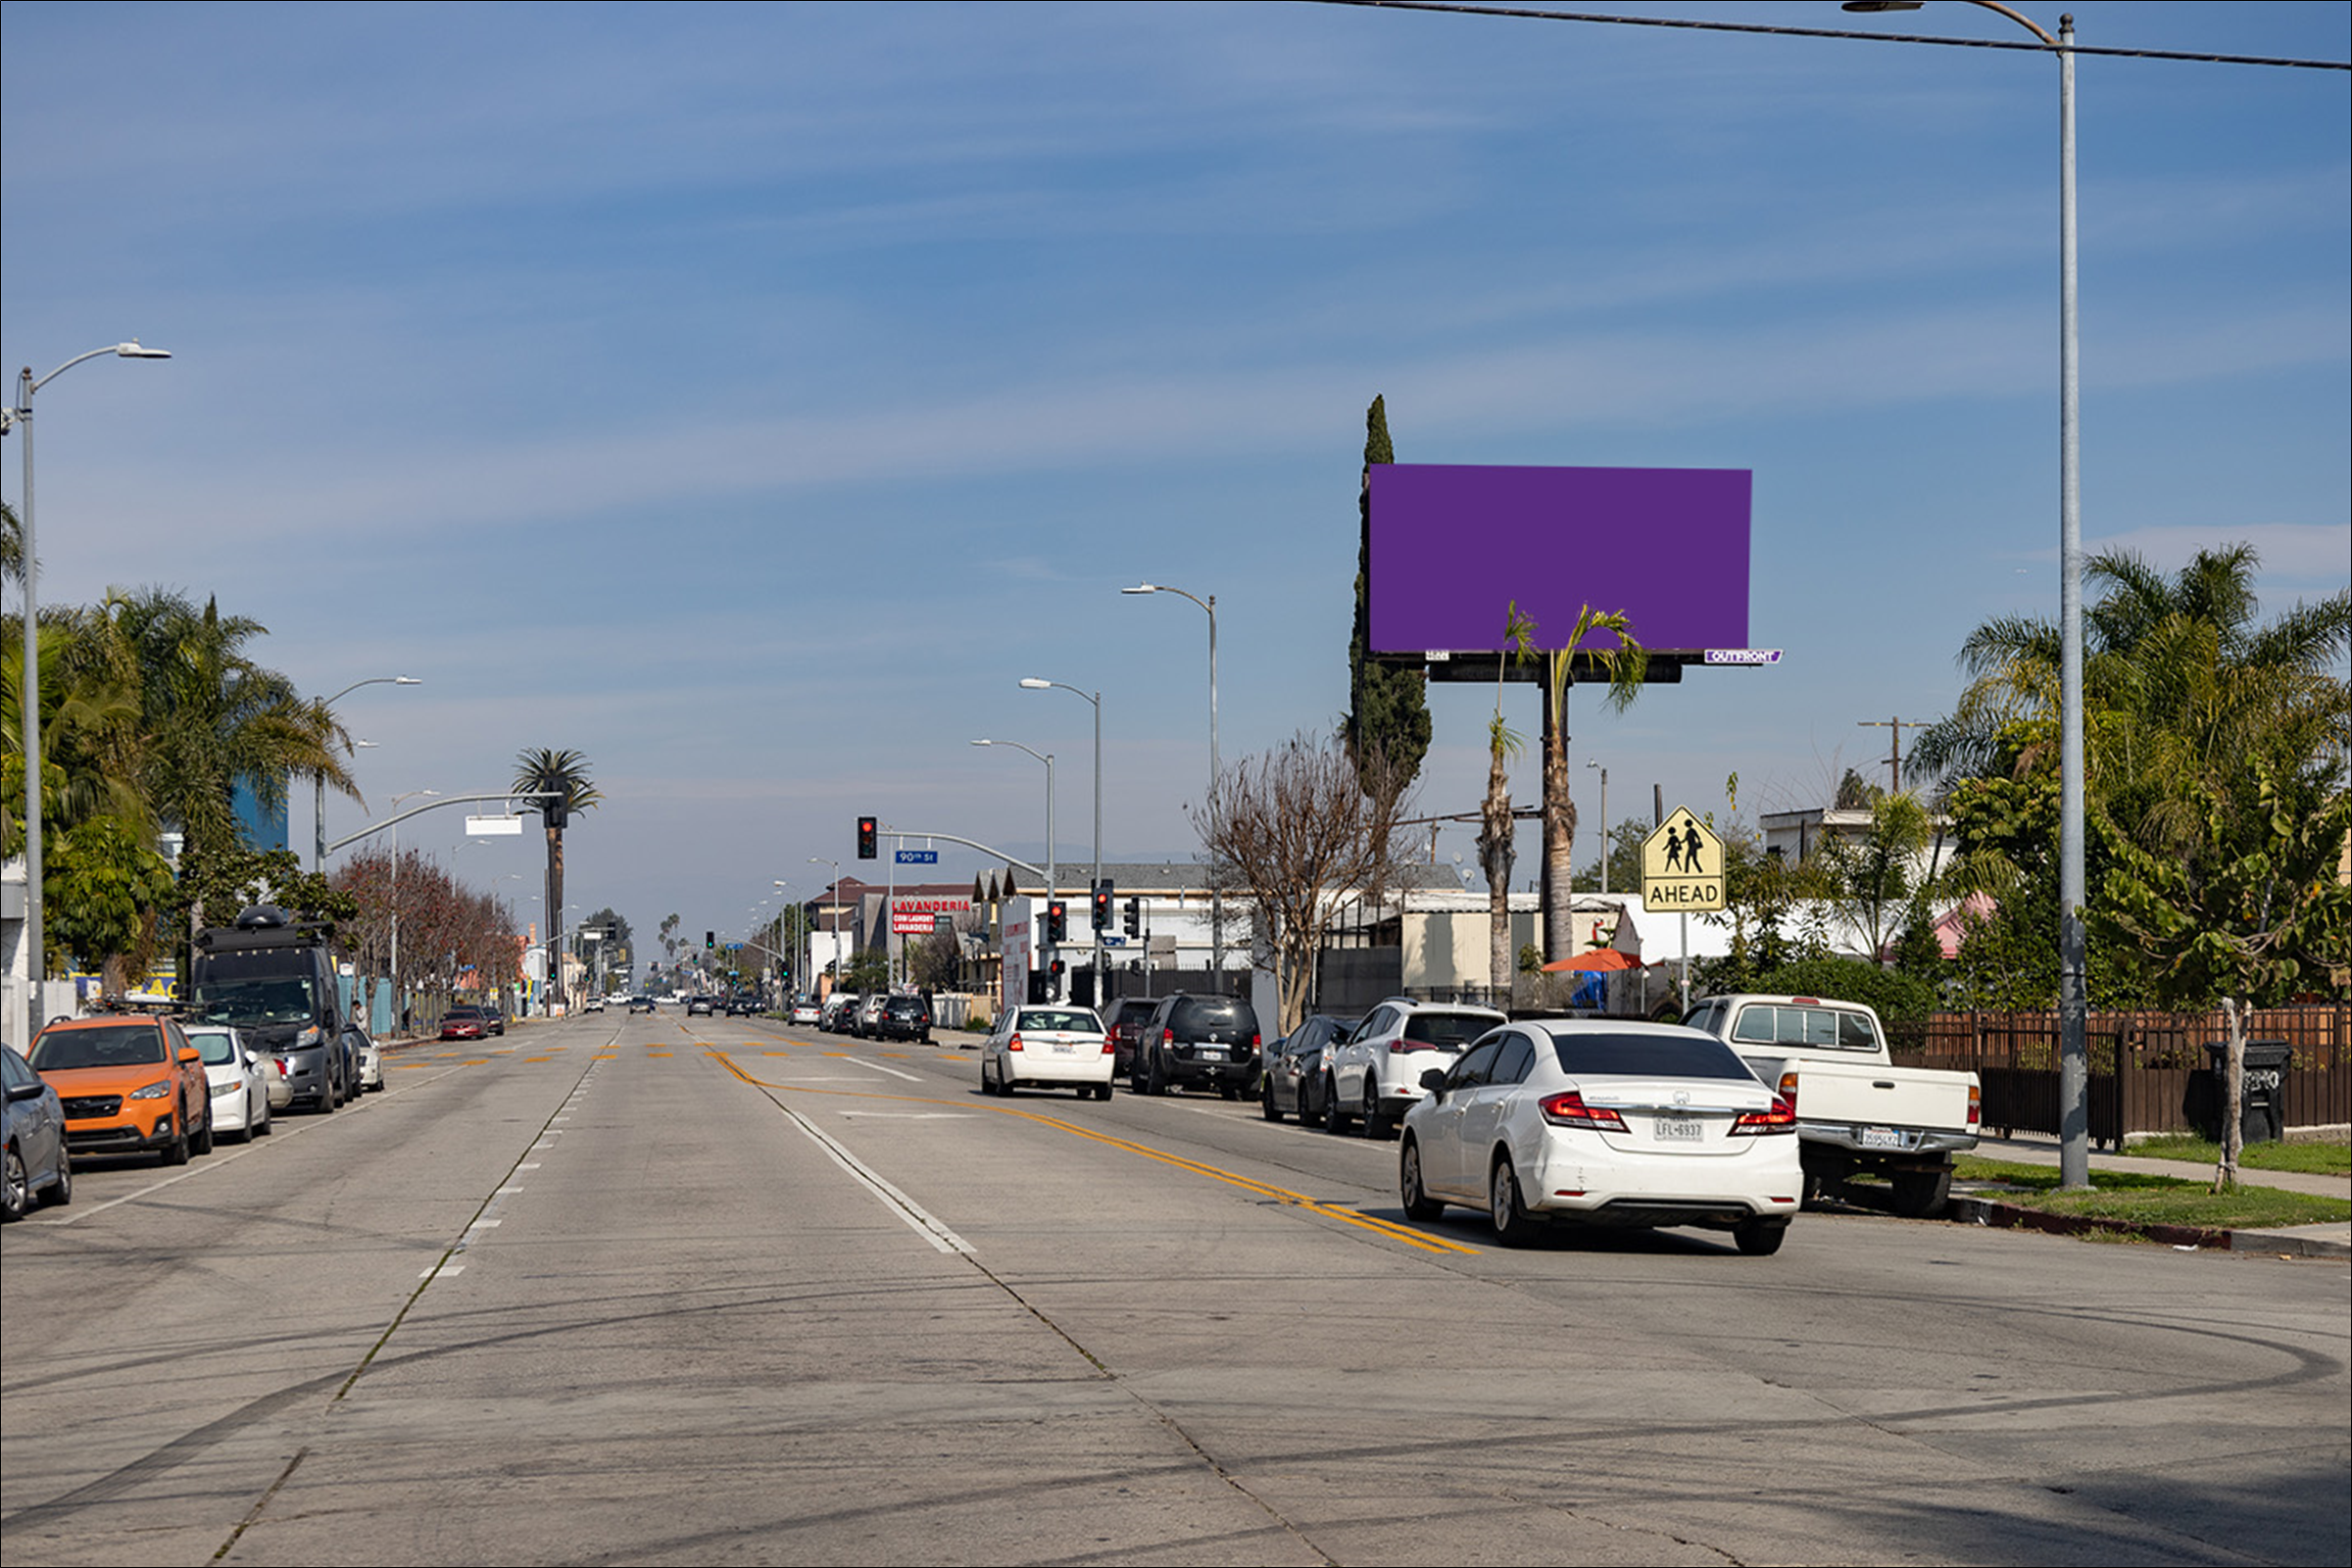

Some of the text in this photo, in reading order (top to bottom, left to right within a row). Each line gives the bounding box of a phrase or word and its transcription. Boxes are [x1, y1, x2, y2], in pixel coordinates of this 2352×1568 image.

[1711, 650, 1775, 662] OUTFRONT
[1649, 884, 1718, 904] AHEAD
[892, 900, 970, 911] LAVANDERIA
